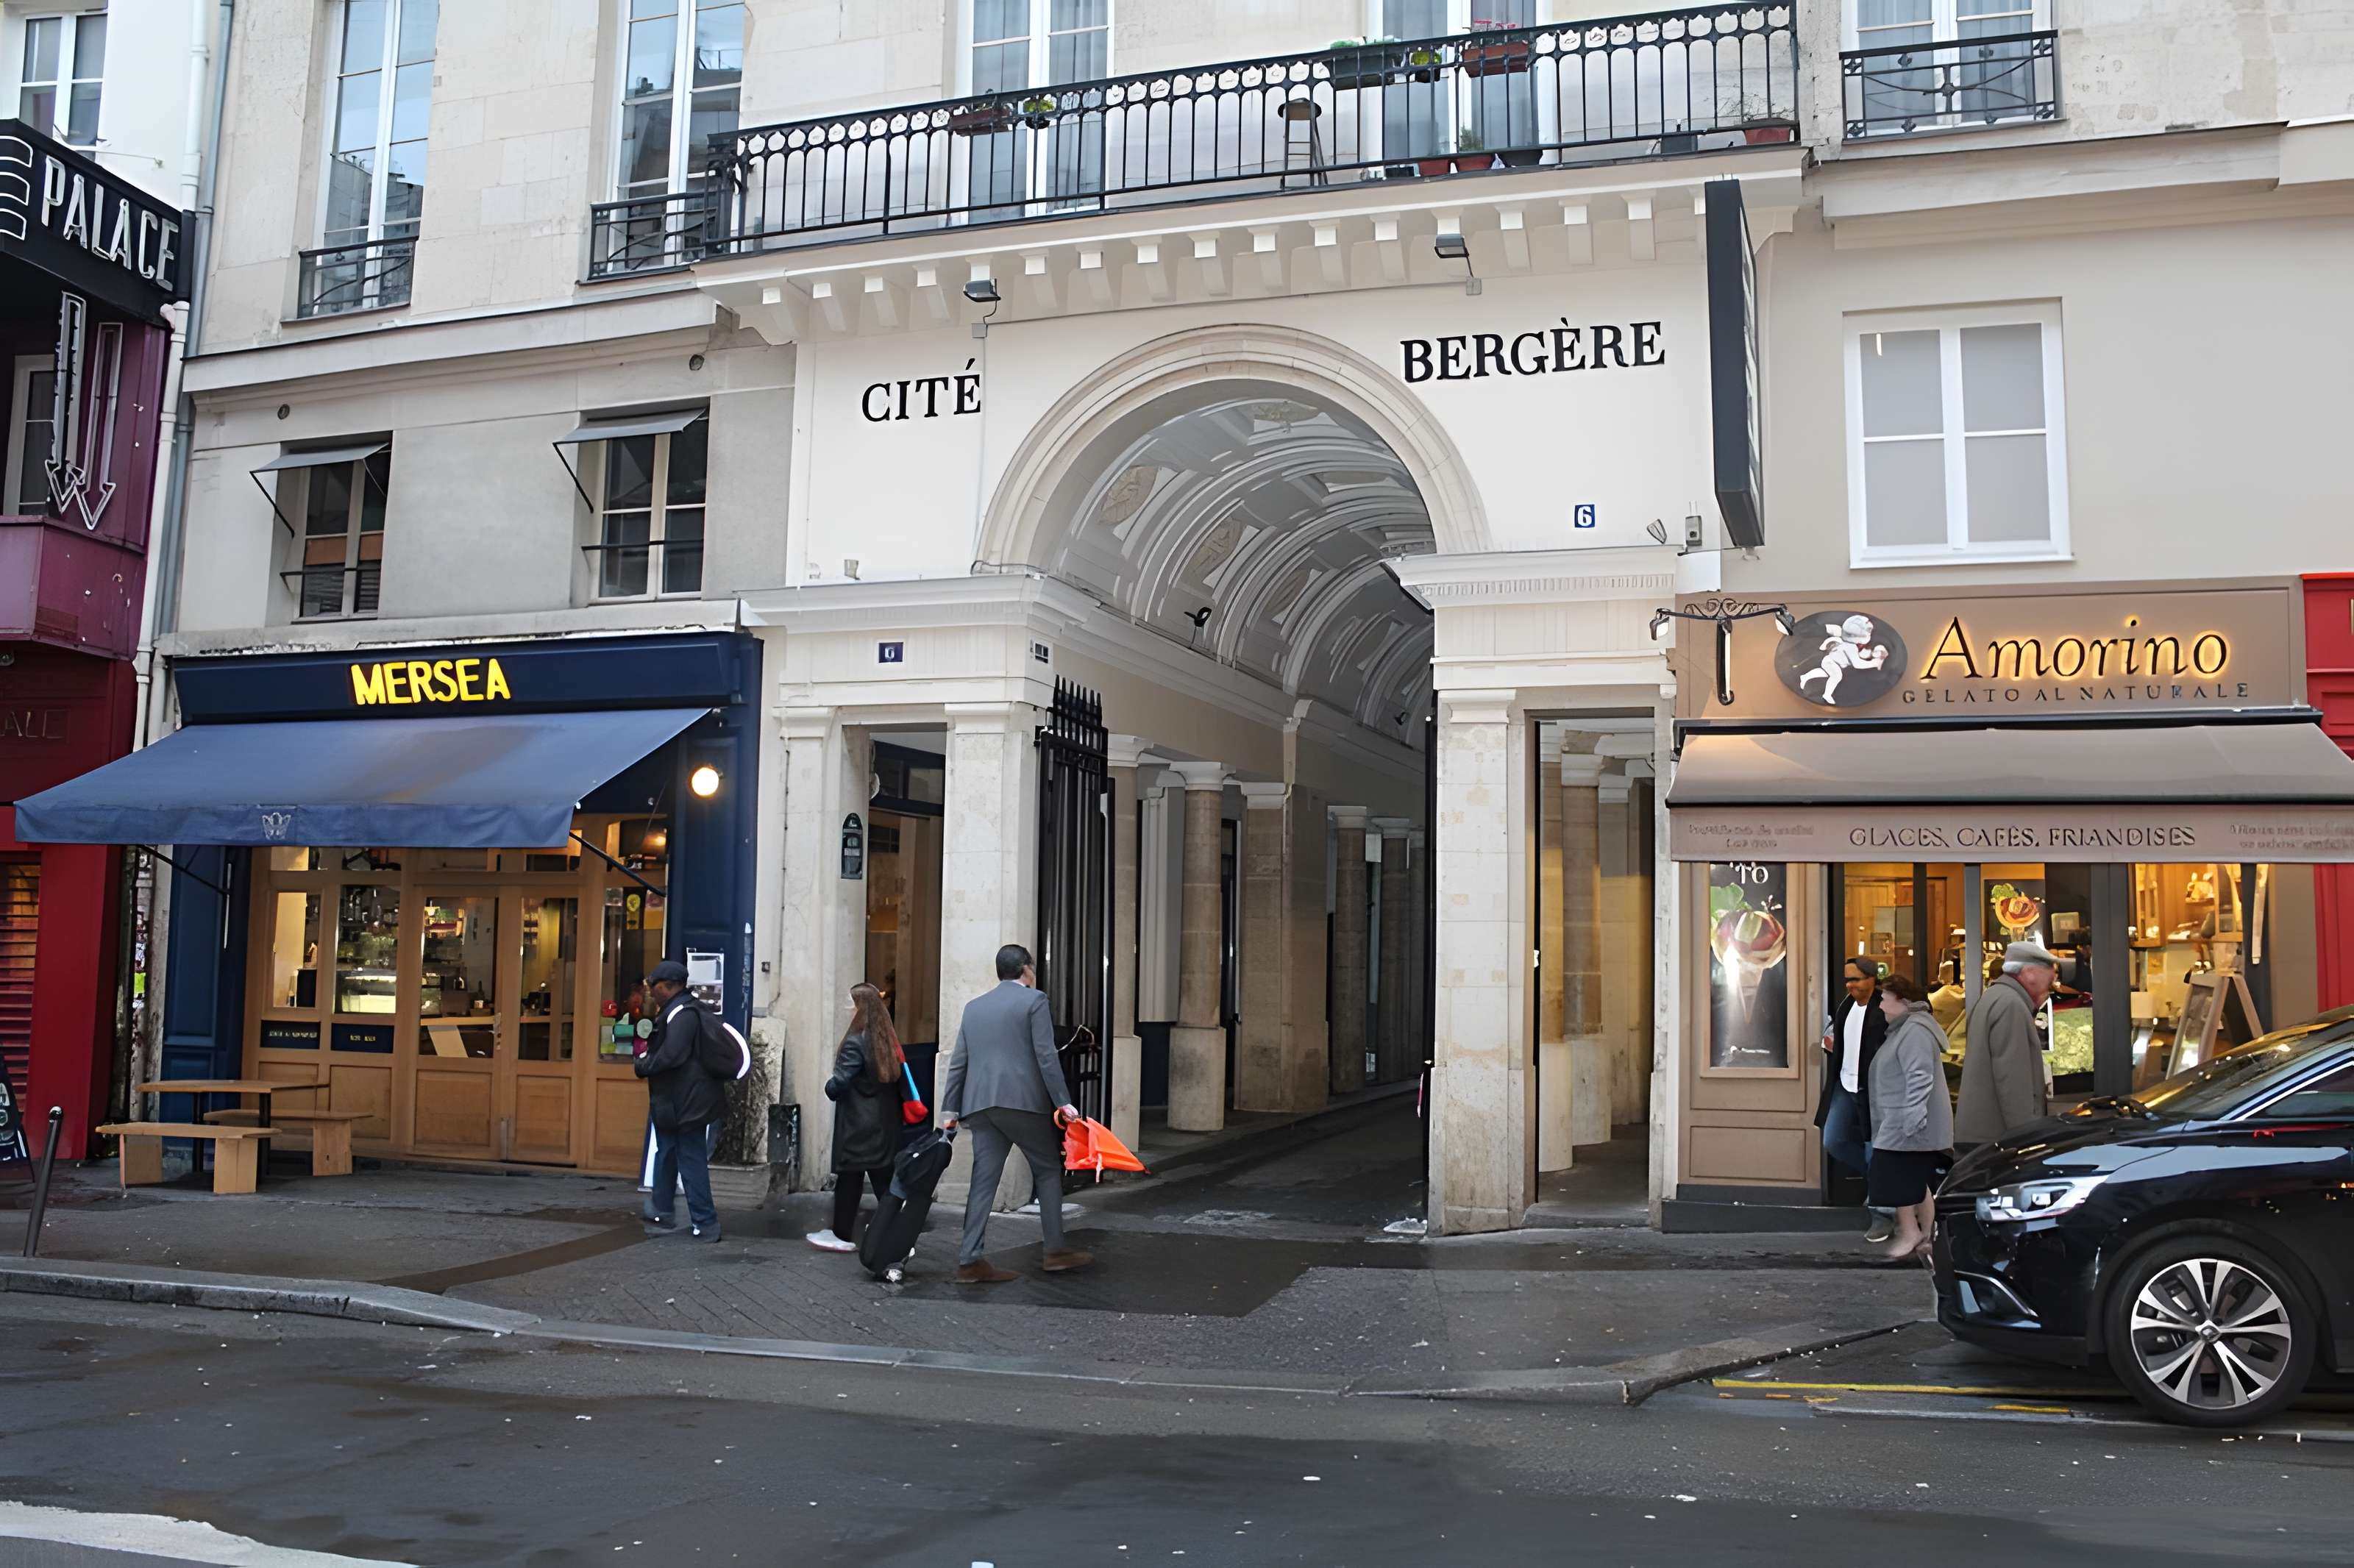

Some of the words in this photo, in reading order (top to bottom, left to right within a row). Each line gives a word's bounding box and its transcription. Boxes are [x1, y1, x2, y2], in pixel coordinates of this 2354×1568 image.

[41, 155, 179, 291] PALACE
[1400, 317, 1665, 383] BERGÈRE
[861, 358, 981, 422] CITÉ
[1578, 506, 1592, 527] 6
[1920, 616, 2227, 680] Amorino
[351, 658, 511, 705] MERSEA
[1902, 688, 2020, 704] GELATO
[2035, 687, 2066, 702] AL
[2080, 683, 2249, 701] NATURALE
[2049, 827, 2197, 847] FRIANDISES
